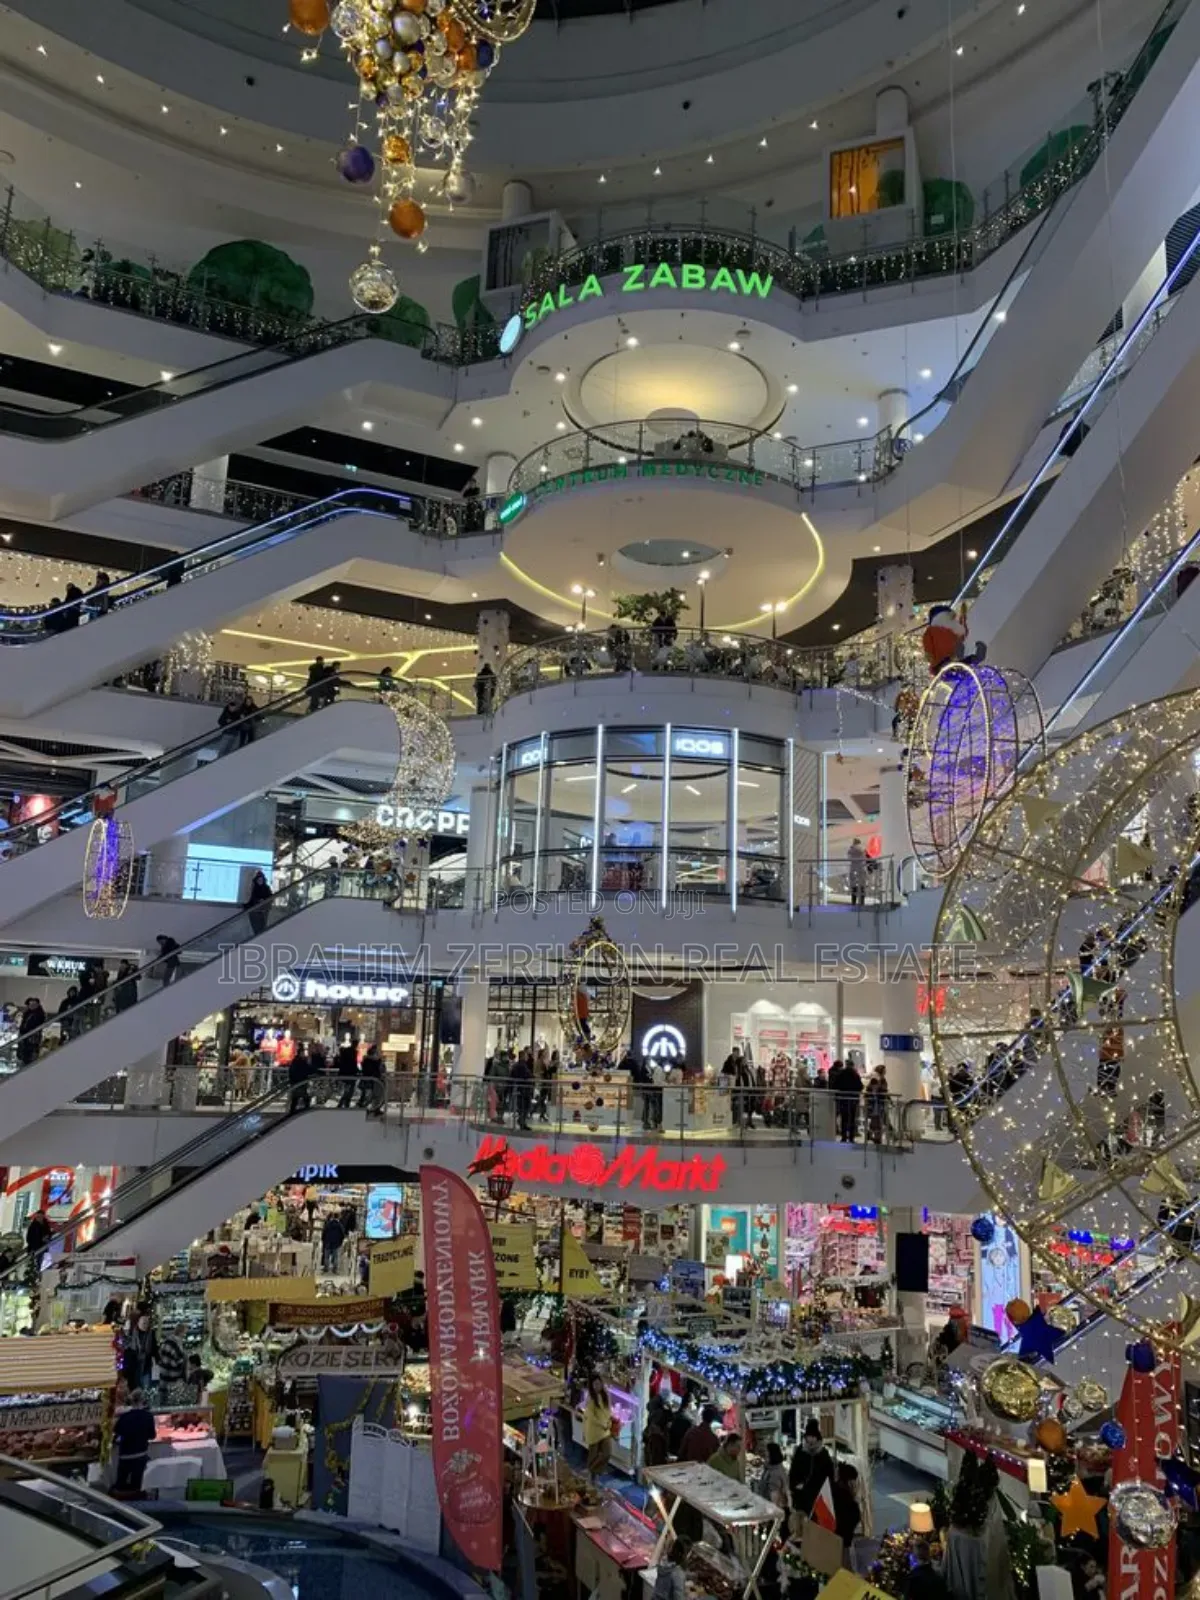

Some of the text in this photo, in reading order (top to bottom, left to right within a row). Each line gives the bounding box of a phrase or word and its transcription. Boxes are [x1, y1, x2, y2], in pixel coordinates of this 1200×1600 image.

[524, 262, 774, 330] SALA ZABAW
[602, 1143, 727, 1192] Markt
[282, 1349, 343, 1368] KOZIE
